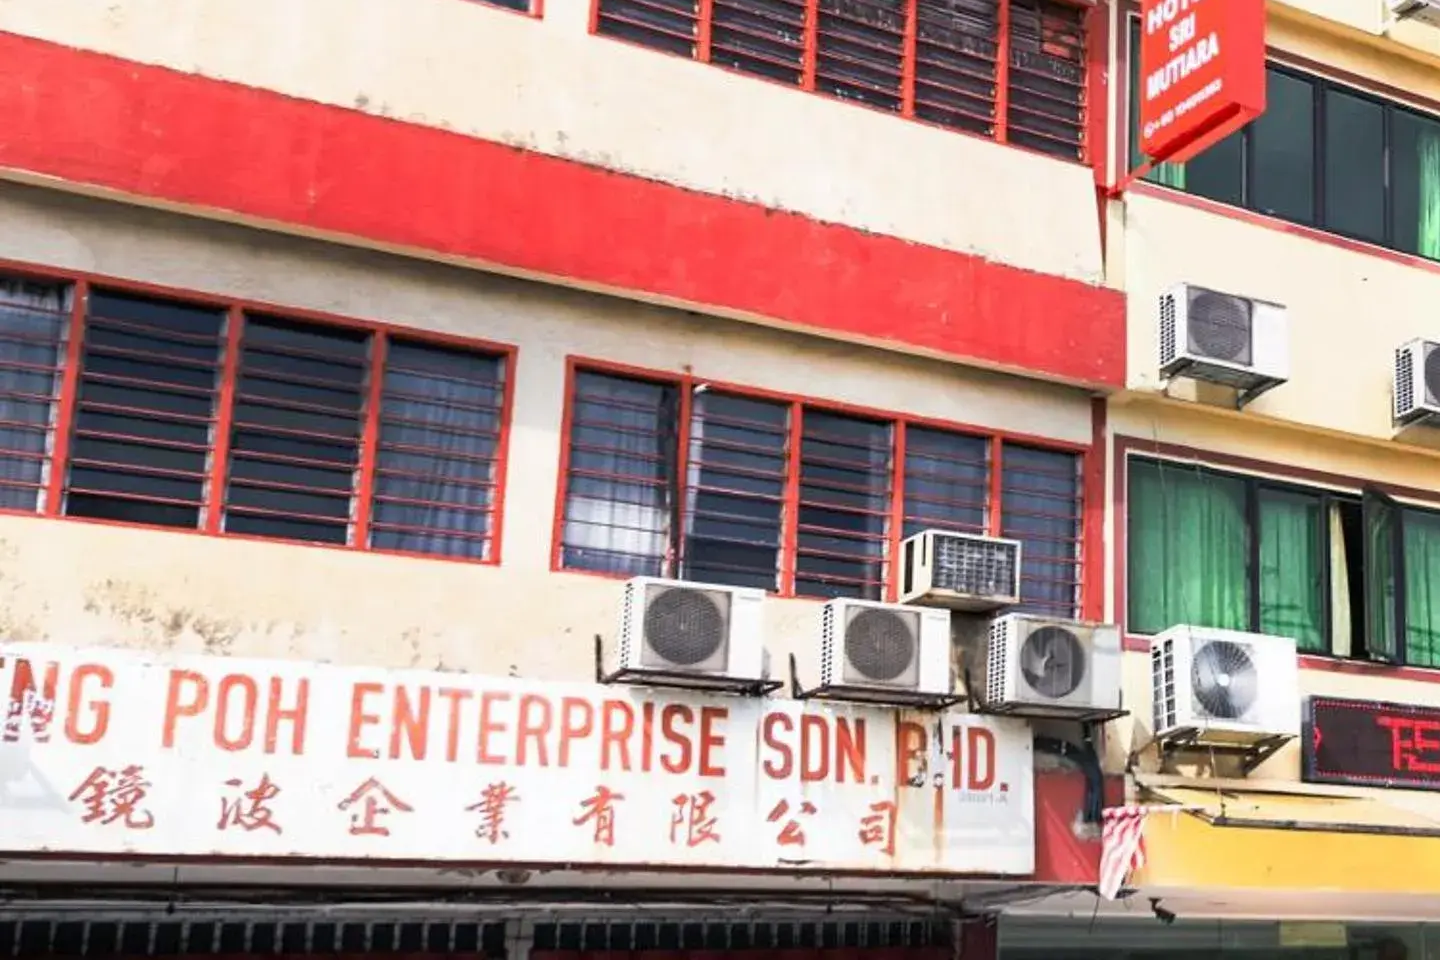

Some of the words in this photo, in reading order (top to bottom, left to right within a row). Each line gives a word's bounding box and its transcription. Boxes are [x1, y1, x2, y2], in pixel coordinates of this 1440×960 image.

[1147, 32, 1220, 100] MUTIARA
[1169, 16, 1196, 51] SRI
[0, 656, 114, 744] NG
[161, 669, 310, 756] POH
[346, 682, 730, 778] ENTERPRISE
[762, 711, 881, 787] SDN.
